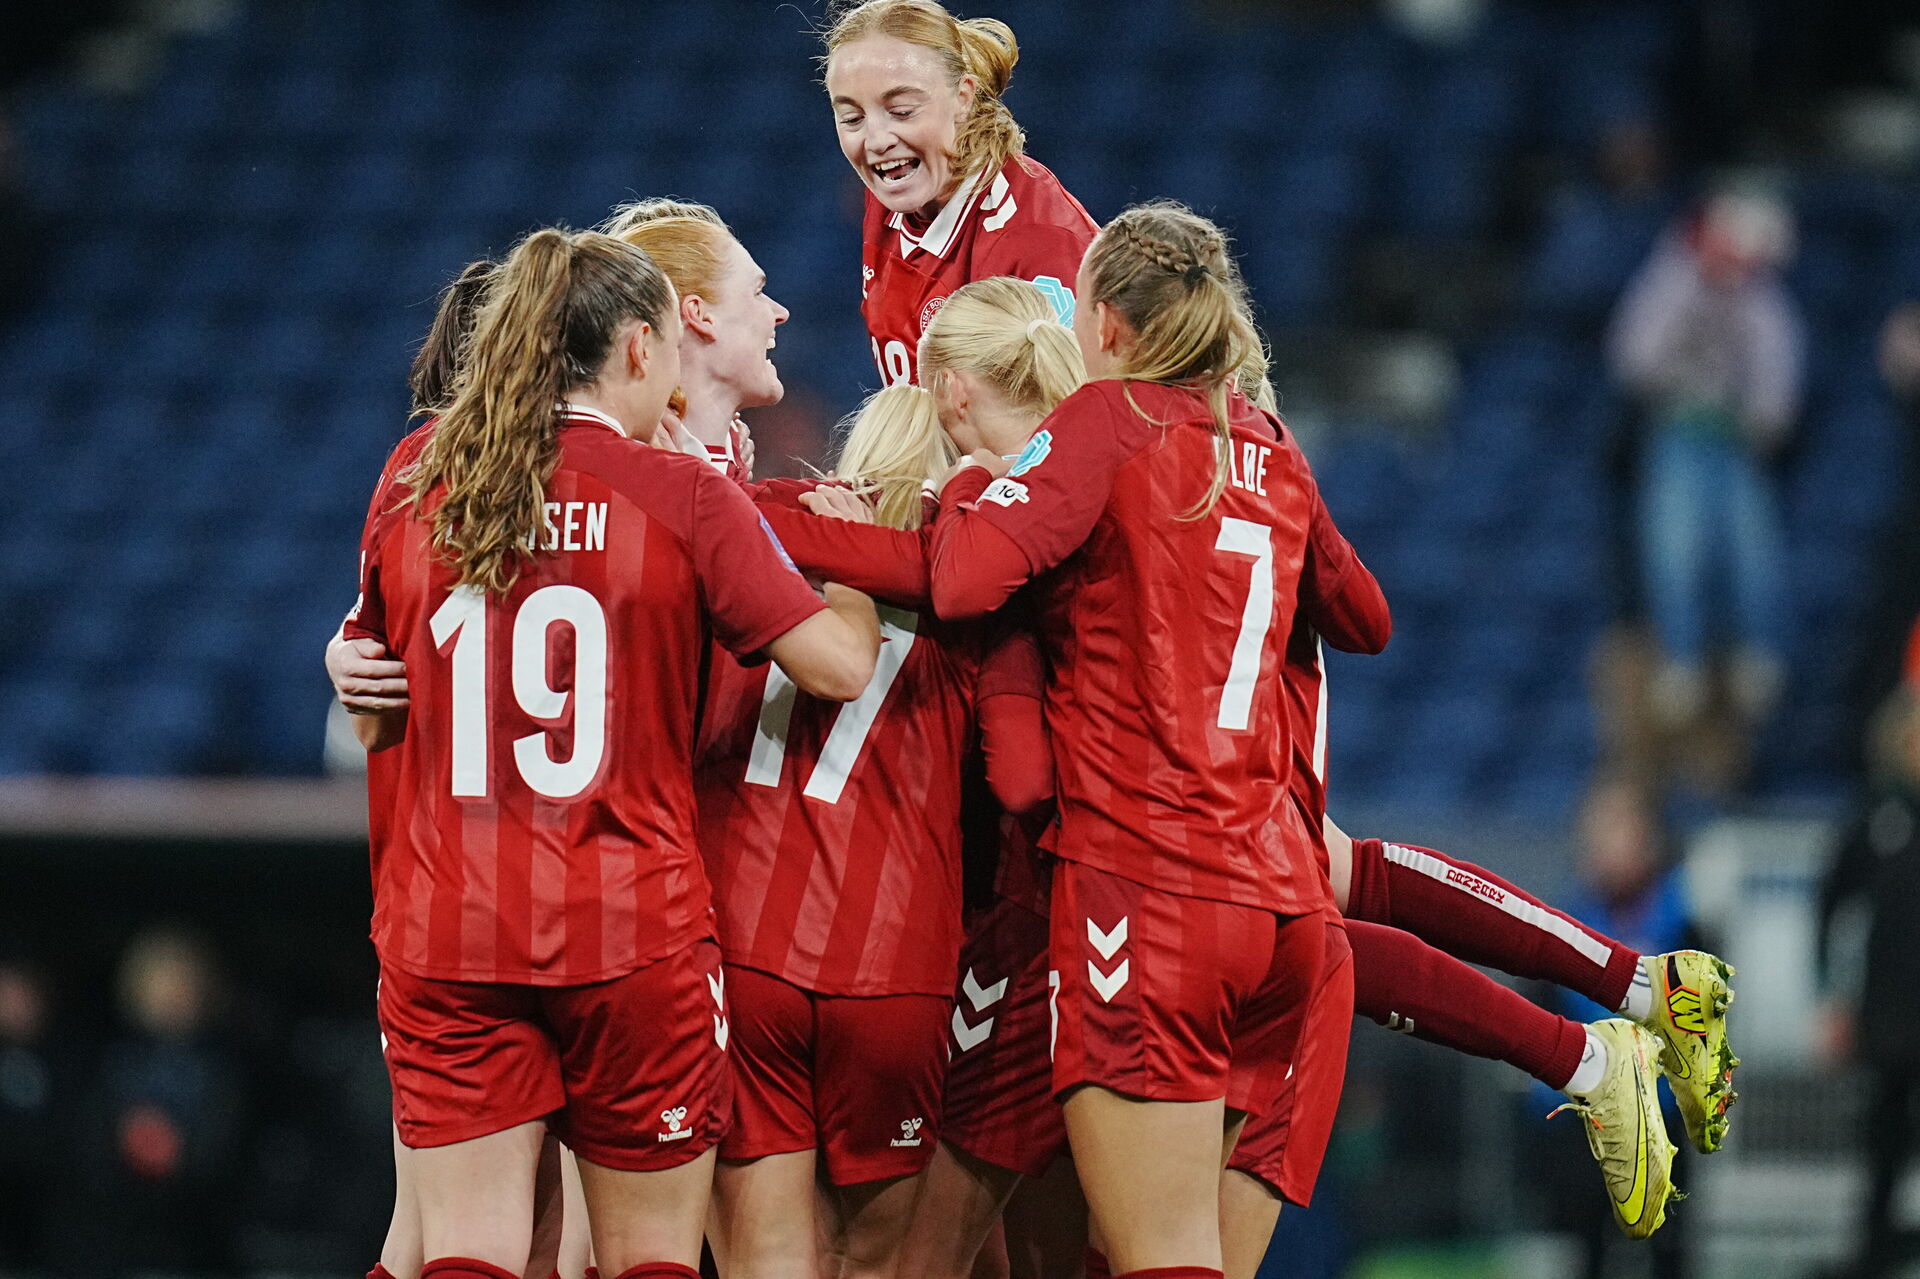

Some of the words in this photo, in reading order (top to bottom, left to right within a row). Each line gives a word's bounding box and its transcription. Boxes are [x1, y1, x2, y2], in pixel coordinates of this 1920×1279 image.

[429, 584, 607, 798] 19
[744, 603, 918, 805] 17
[1214, 516, 1273, 730] 7
